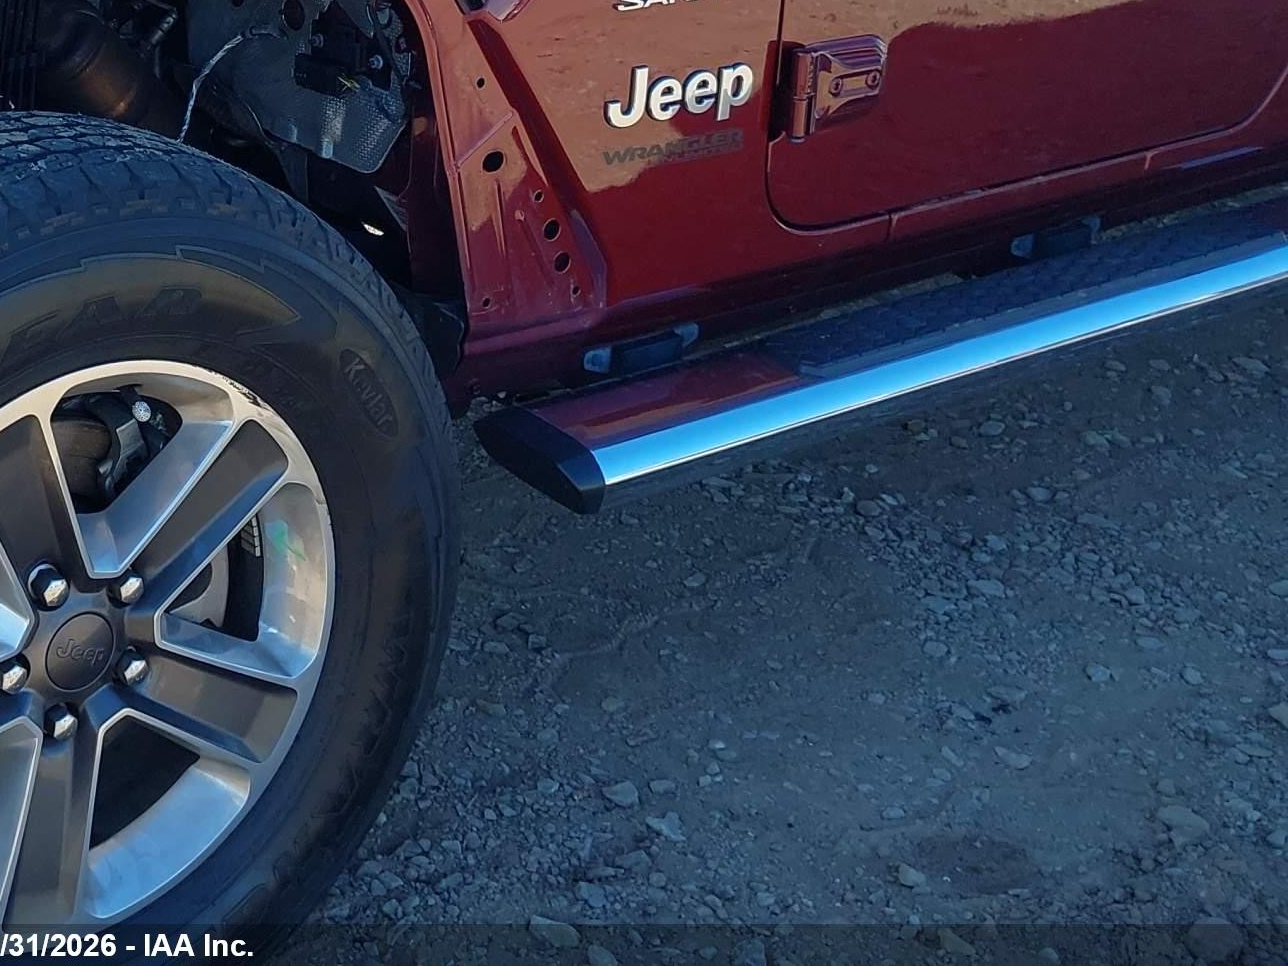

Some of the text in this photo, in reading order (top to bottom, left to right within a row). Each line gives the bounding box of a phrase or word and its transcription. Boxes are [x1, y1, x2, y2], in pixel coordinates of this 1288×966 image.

[603, 62, 754, 128] Jeep
[602, 130, 743, 166] WRANGLER
[55, 637, 105, 667] Jeep
